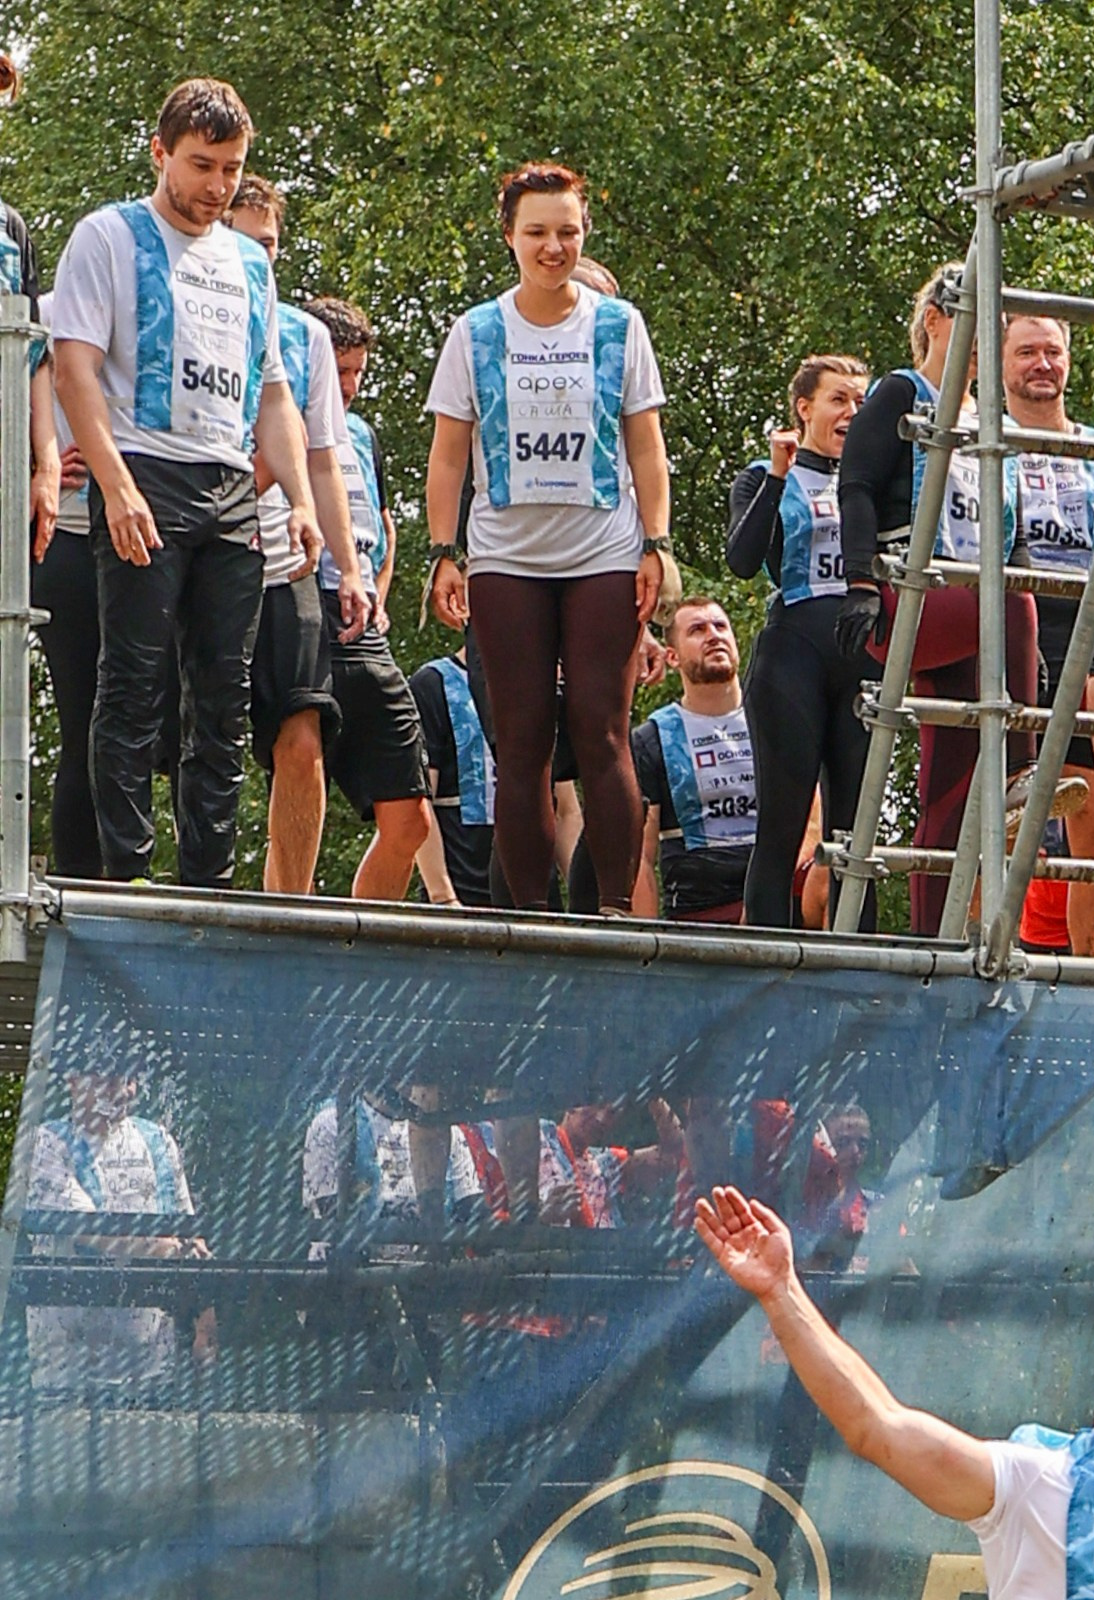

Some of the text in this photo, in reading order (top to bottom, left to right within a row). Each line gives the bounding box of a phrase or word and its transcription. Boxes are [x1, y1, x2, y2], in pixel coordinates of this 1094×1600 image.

[185, 299, 243, 327] apex
[511, 351, 589, 364] ГОНКА ГЕРОЕВ
[182, 358, 241, 402] 5450
[517, 376, 583, 393] apex
[516, 432, 586, 462] 5447
